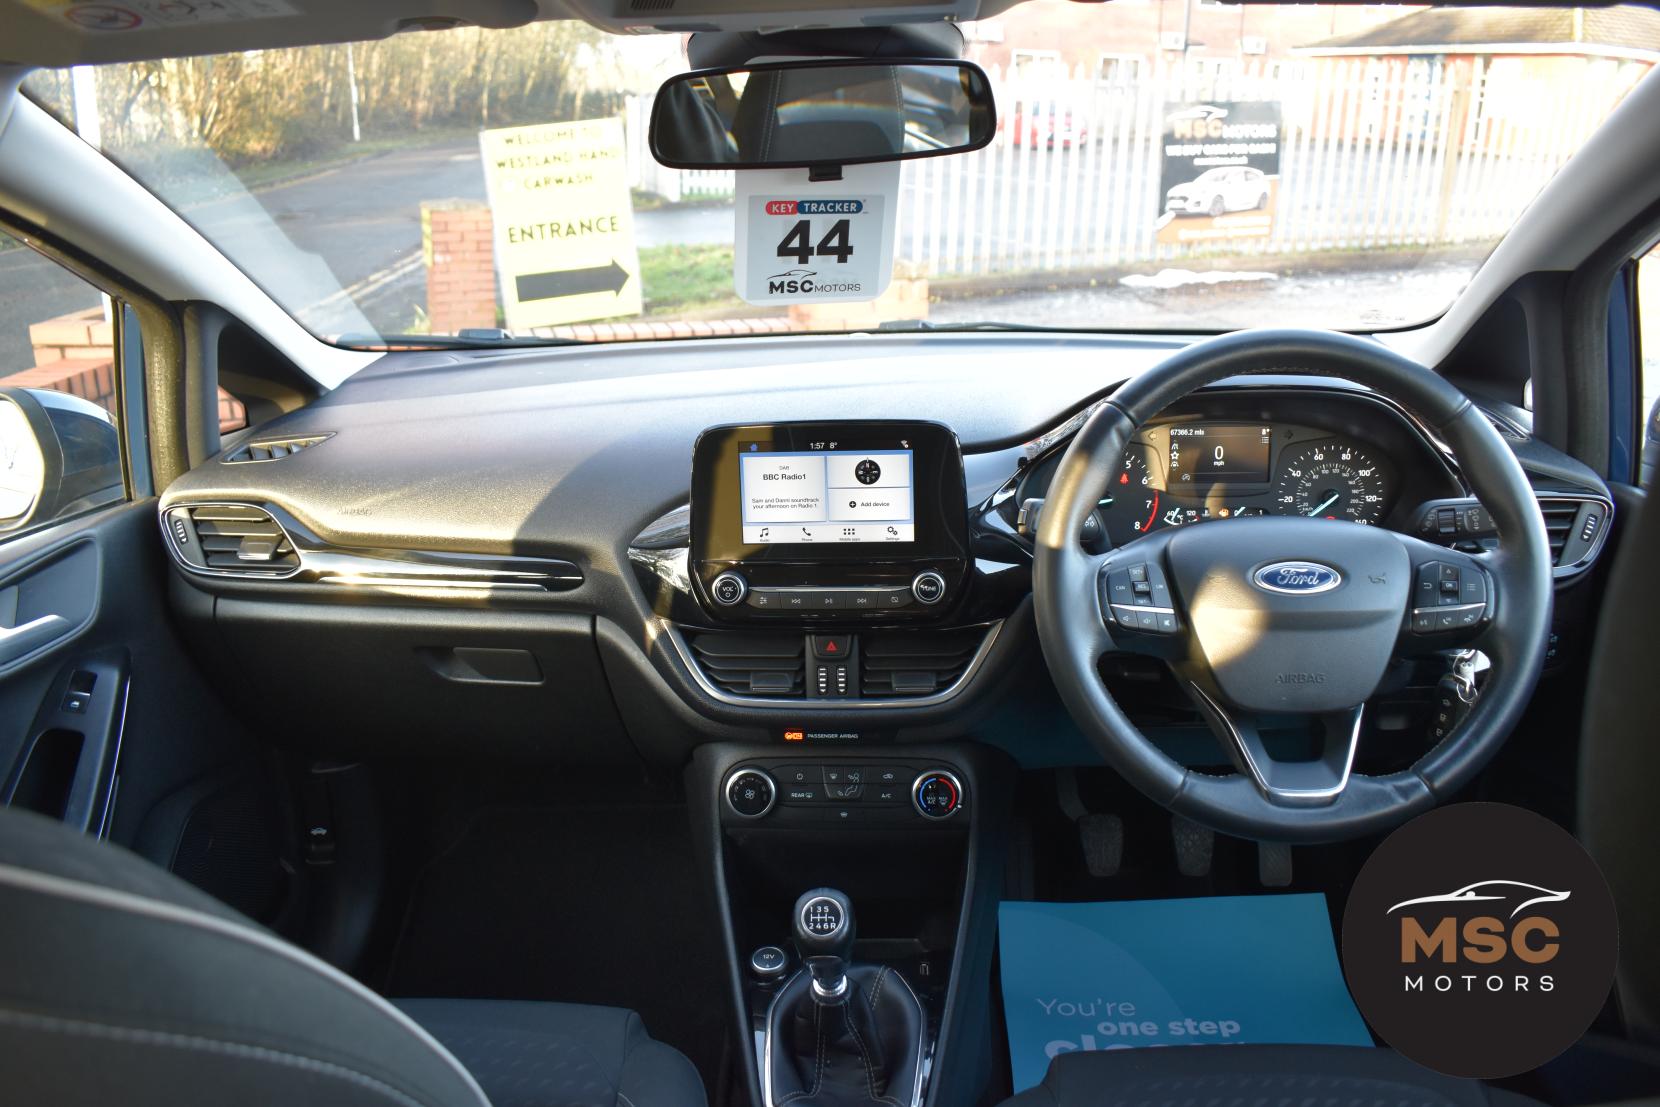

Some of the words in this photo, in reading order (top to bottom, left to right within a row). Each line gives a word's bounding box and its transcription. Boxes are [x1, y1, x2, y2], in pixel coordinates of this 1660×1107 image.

[1174, 119, 1222, 138] MSC
[771, 203, 794, 213] KEY
[804, 202, 858, 212] TRACKER
[508, 216, 620, 243] ENTRANCE
[777, 219, 854, 264] 44
[769, 280, 814, 294] MSC
[814, 284, 861, 293] MOTORS
[1214, 446, 1224, 460] 0
[1142, 477, 1148, 485] 6
[1146, 500, 1152, 508] 7
[1135, 522, 1141, 530] 8
[1277, 568, 1319, 584] Ford
[1274, 673, 1326, 684] AIRBAG
[1036, 998, 1136, 1016] You're
[1097, 1021, 1159, 1036] one
[1168, 1018, 1240, 1037] step
